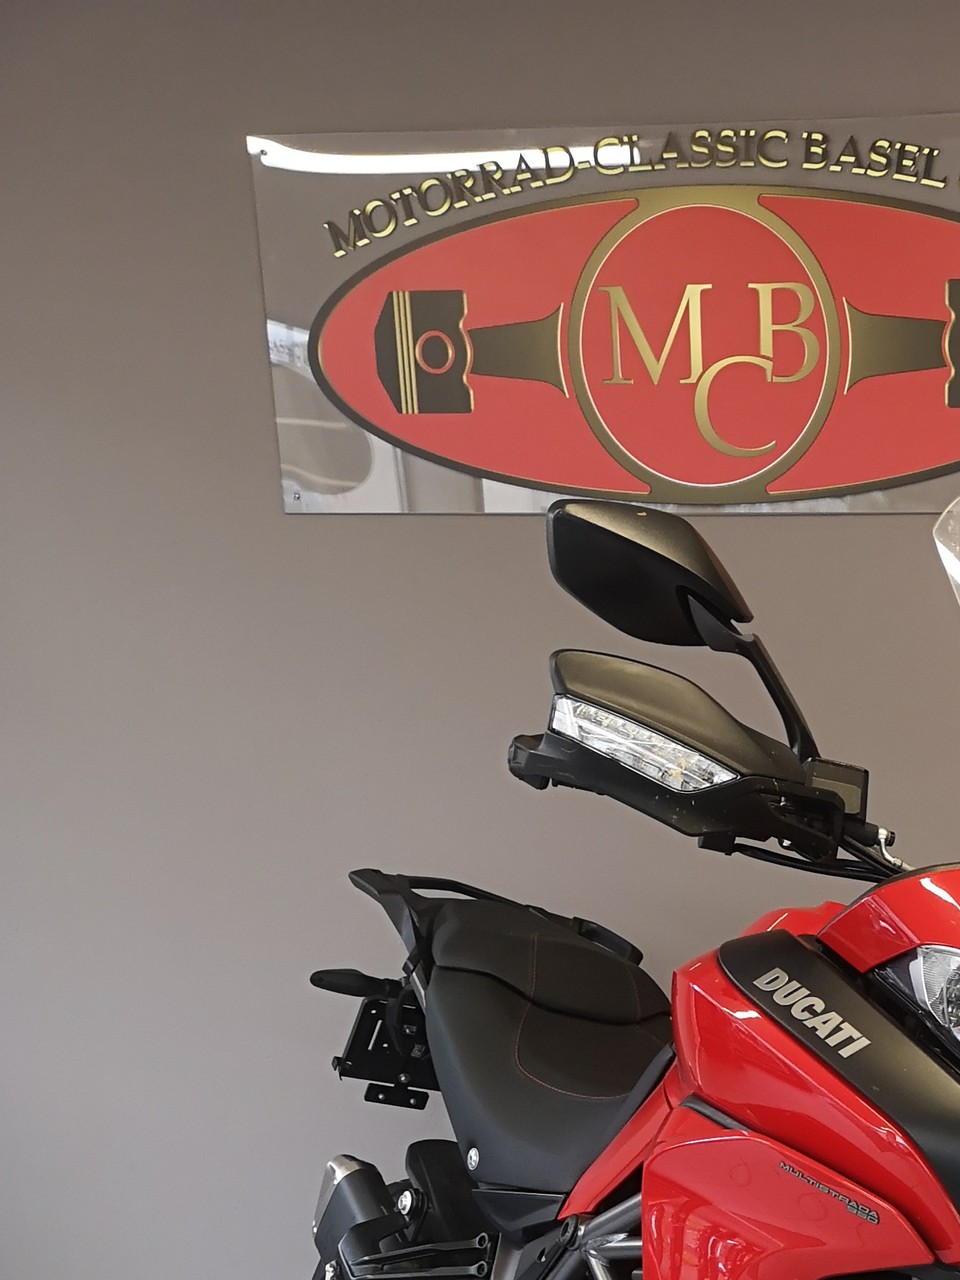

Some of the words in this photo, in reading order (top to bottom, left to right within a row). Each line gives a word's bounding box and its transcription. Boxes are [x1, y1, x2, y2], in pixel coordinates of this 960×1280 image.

[801, 131, 947, 189] BASEL
[752, 967, 872, 1059] DUCATI
[779, 1161, 879, 1219] MULTISTRADA
